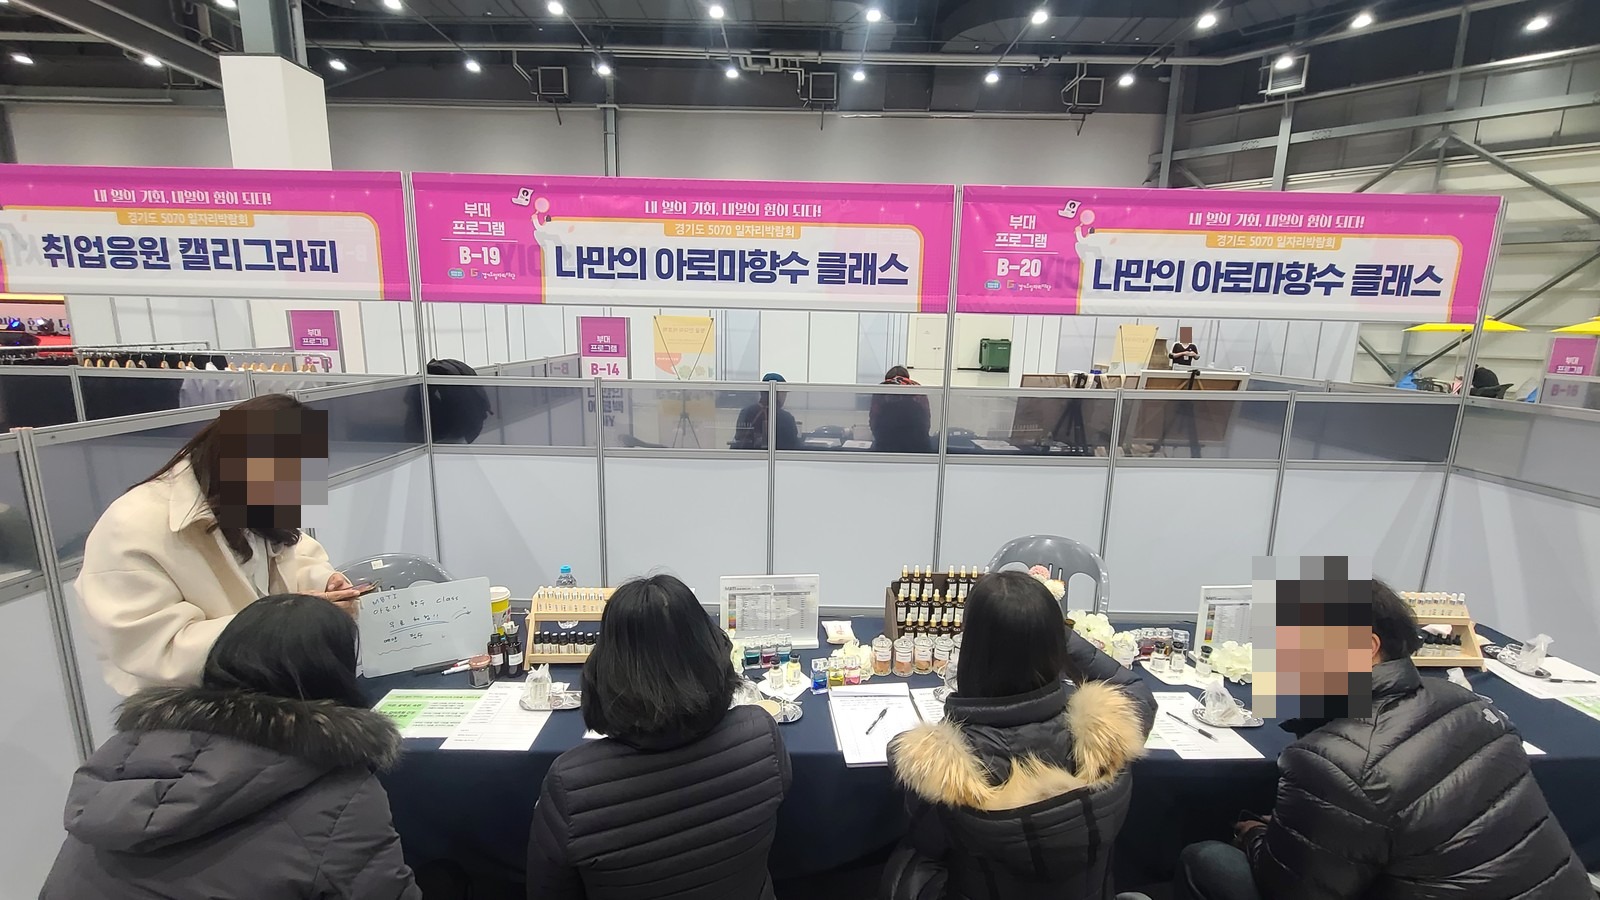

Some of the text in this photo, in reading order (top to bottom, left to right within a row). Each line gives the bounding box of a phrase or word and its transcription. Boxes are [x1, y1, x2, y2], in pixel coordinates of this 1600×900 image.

[94, 189, 272, 205] 내 일의 기회, 내일의 힘이 되다!
[464, 202, 491, 218] 부대
[645, 200, 822, 218] 내 일의 기회, 내일의 힘이 되다!
[128, 212, 249, 226] 경기도 5070 일자리박람회
[1009, 214, 1036, 230] 부대
[1189, 211, 1365, 229] 내 일의 기회, 내일의 힘이 되다!
[452, 220, 505, 237] 프로그램
[675, 223, 795, 238] 경기도 5070 일자리박람회
[994, 232, 1047, 249] 프로그램
[1216, 234, 1336, 249] 경기도 5070 일자리박람회
[41, 233, 339, 273] 취업응원 캘리그라피
[459, 246, 500, 265] B-19
[555, 246, 909, 286] 나만의 아로마향수 클래스
[996, 258, 1042, 277] B-20
[1092, 258, 1186, 292] 나만의
[1191, 260, 1345, 296] 아로마향수
[1350, 263, 1443, 297] 클래스
[302, 337, 329, 346] 프로그램
[596, 335, 611, 343] 부대
[590, 344, 618, 353] 프로그램
[591, 362, 620, 376] B-14
[372, 593, 397, 605] MBTI
